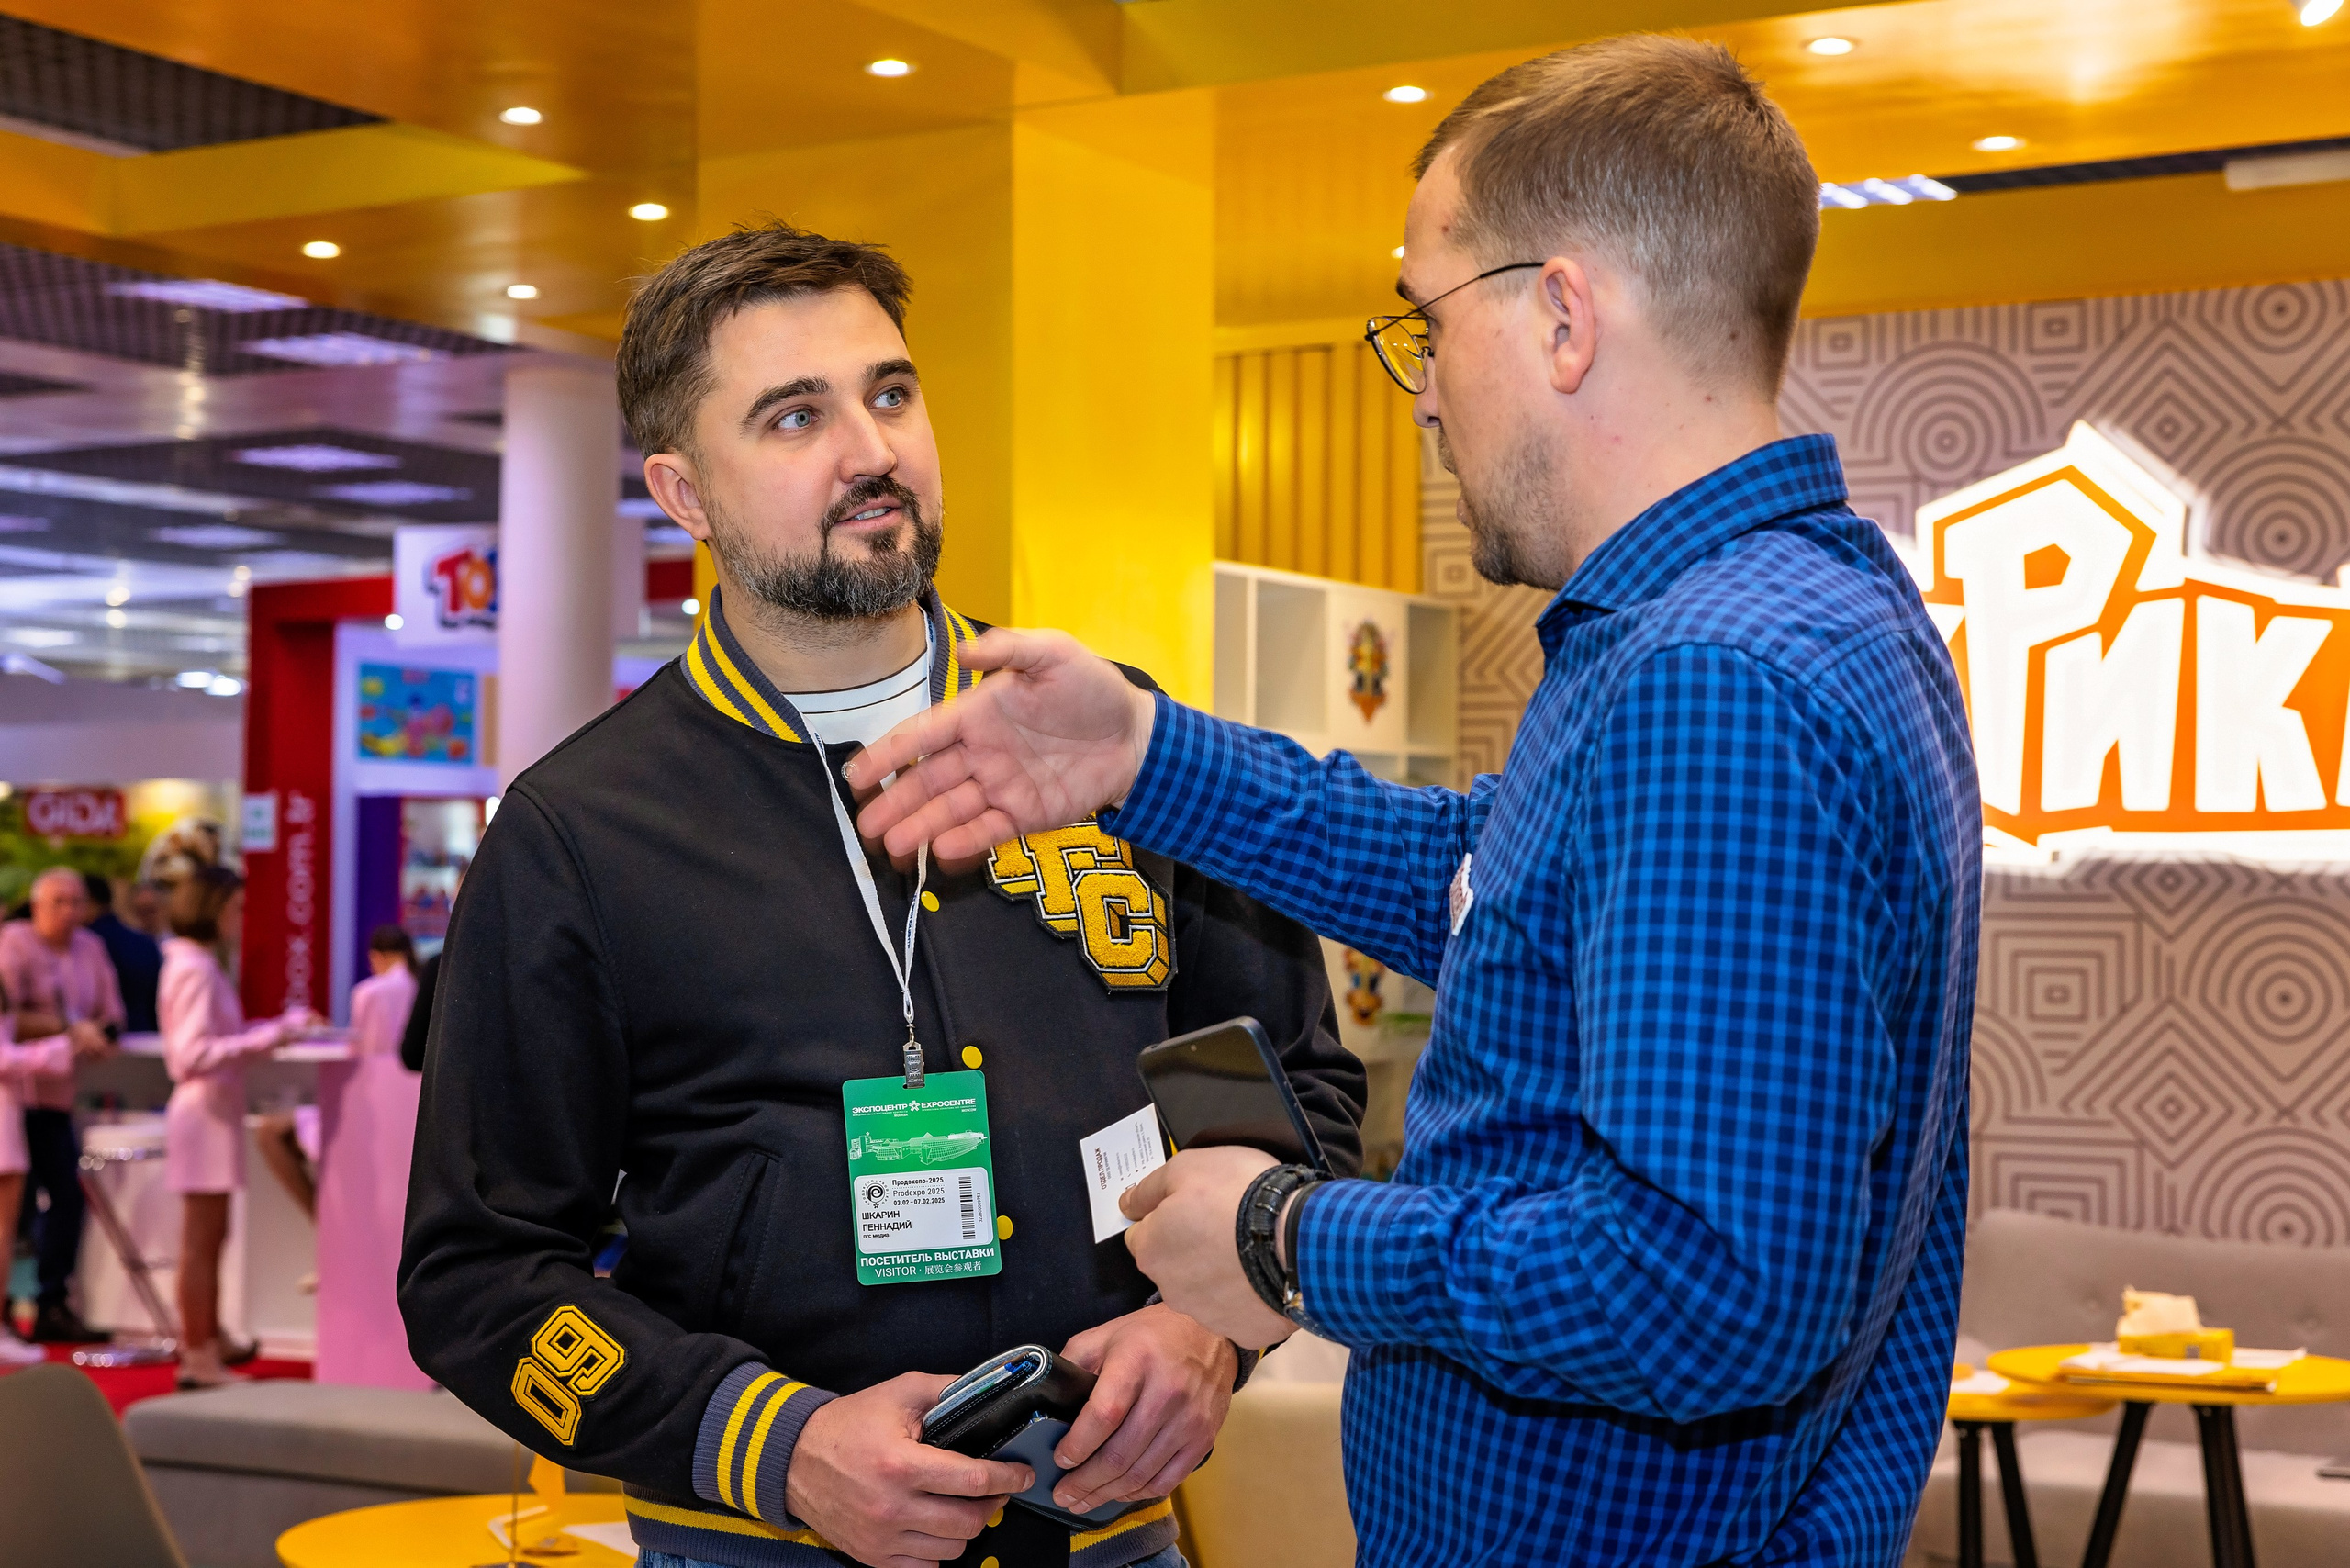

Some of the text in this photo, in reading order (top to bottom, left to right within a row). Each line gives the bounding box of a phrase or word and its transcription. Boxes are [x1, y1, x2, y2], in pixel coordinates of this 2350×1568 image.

[852, 1103, 908, 1114] ЭКСПОЦЕНТР
[921, 1099, 977, 1108] EXPOCENTRE
[1095, 1148, 1107, 1190] ОТДЕЛ ПРОДАЖ
[891, 1176, 944, 1186] Продэкспо-2025
[892, 1187, 945, 1197] Prodexpo 2025
[861, 1210, 901, 1220] ШКАРИН
[862, 1220, 912, 1232] ГЕННАДИЙ
[860, 1248, 994, 1267] ПОСЕТИТЕЛЬ ВЫСТАВКИ
[874, 1266, 916, 1278] VISITOR
[510, 1305, 625, 1446] 09
